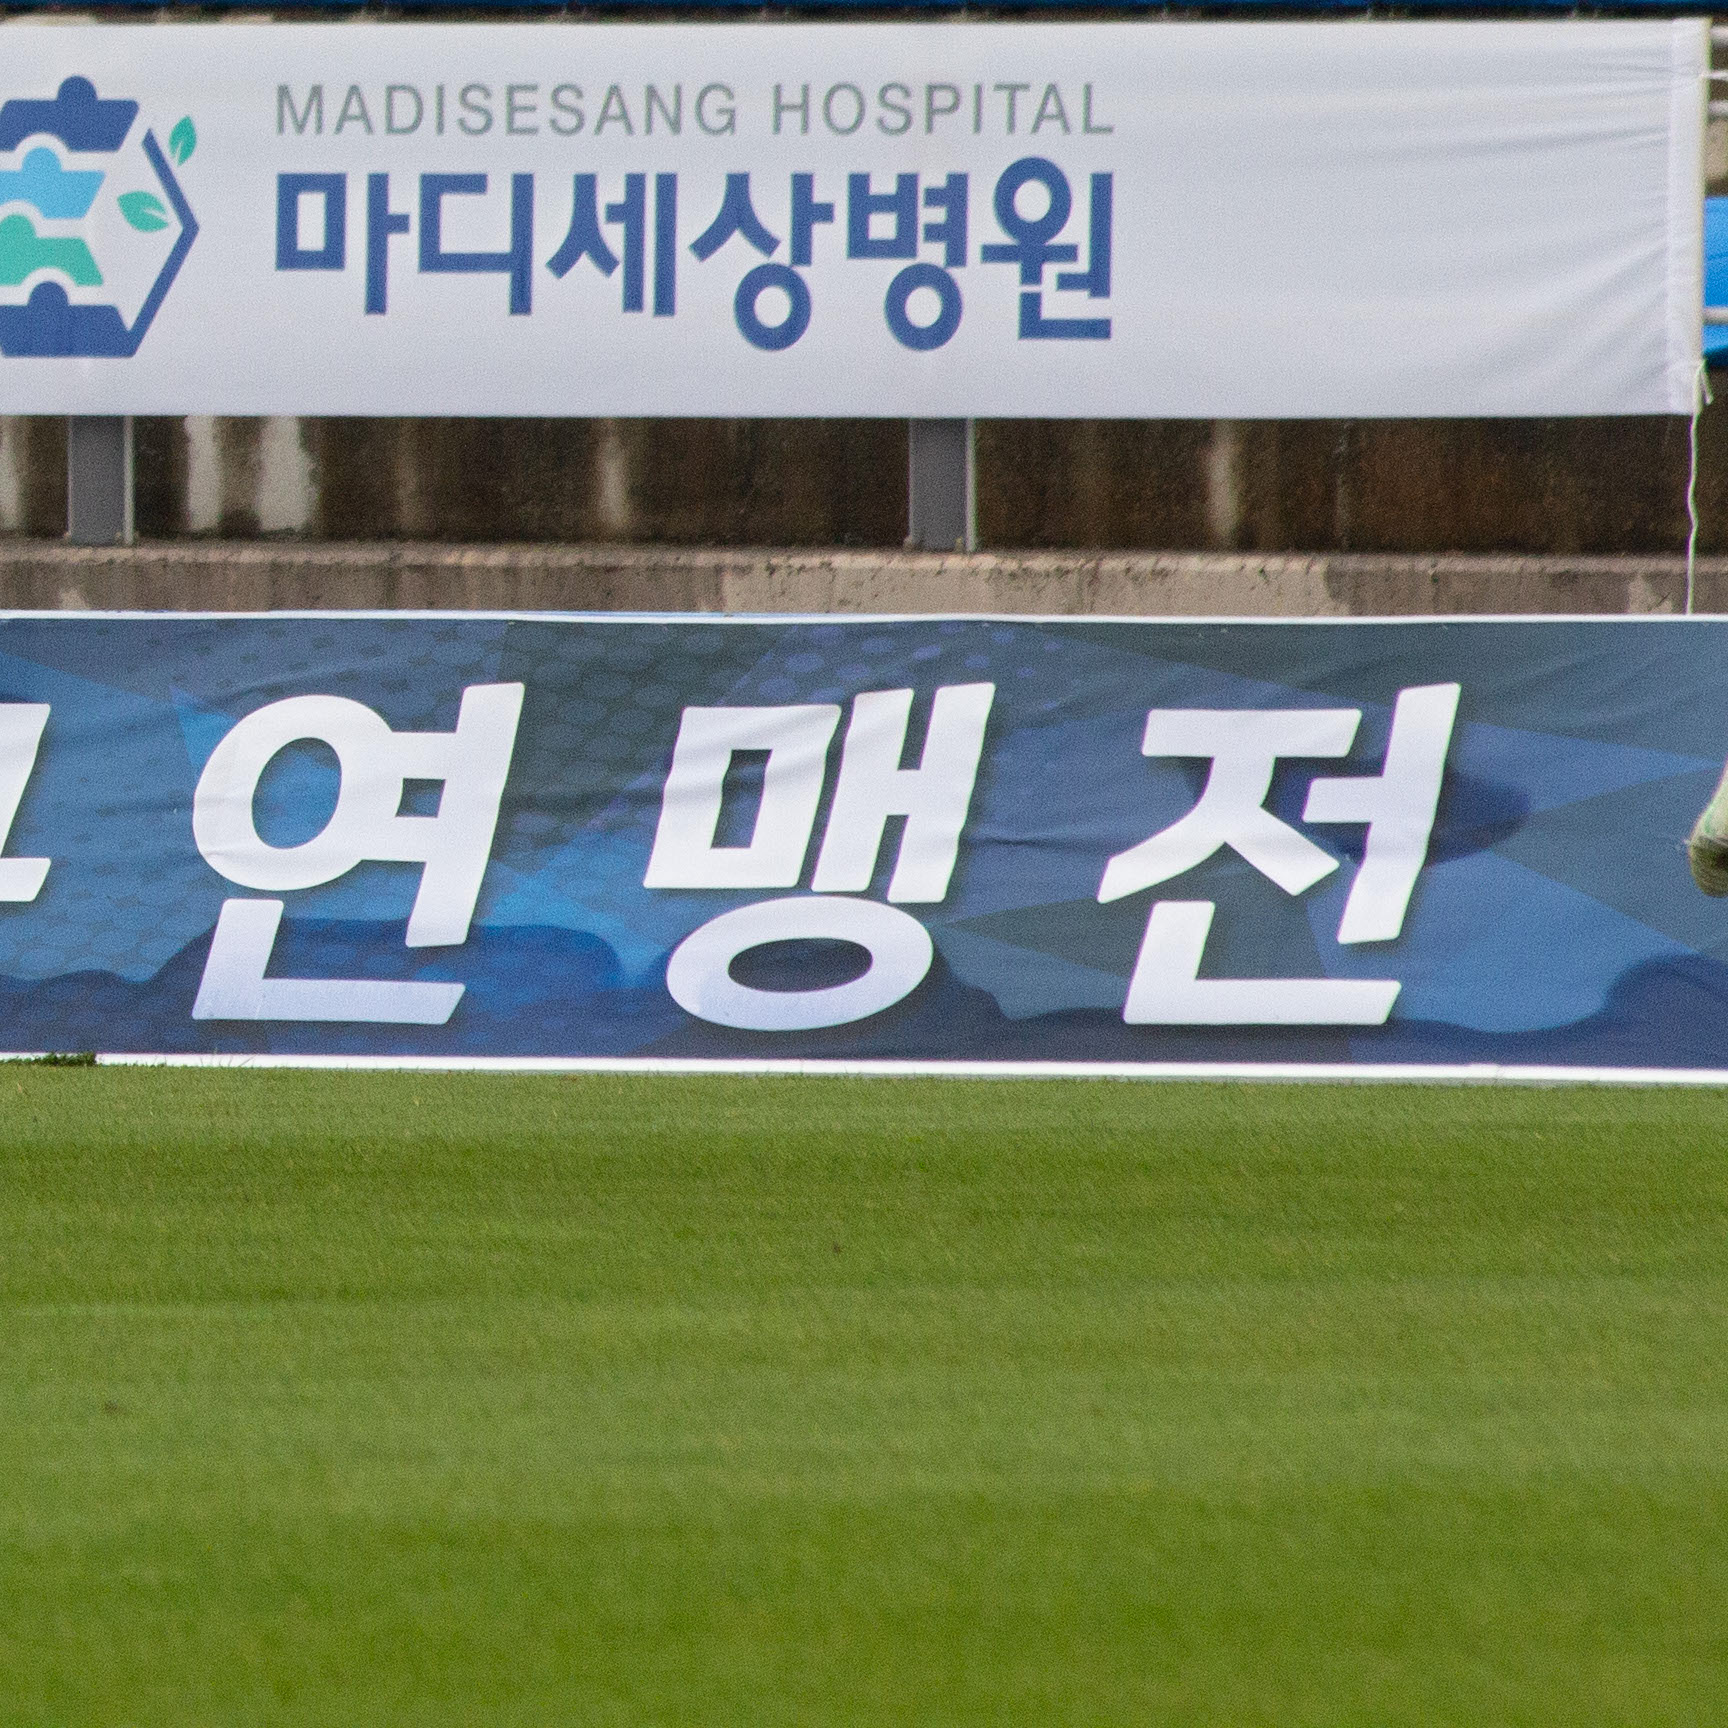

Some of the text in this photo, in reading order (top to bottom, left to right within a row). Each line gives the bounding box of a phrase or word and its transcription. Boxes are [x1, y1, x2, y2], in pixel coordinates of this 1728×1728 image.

[276, 81, 1116, 137] MADISESANG HOSPITAL
[273, 155, 1115, 353] 마디세상병원
